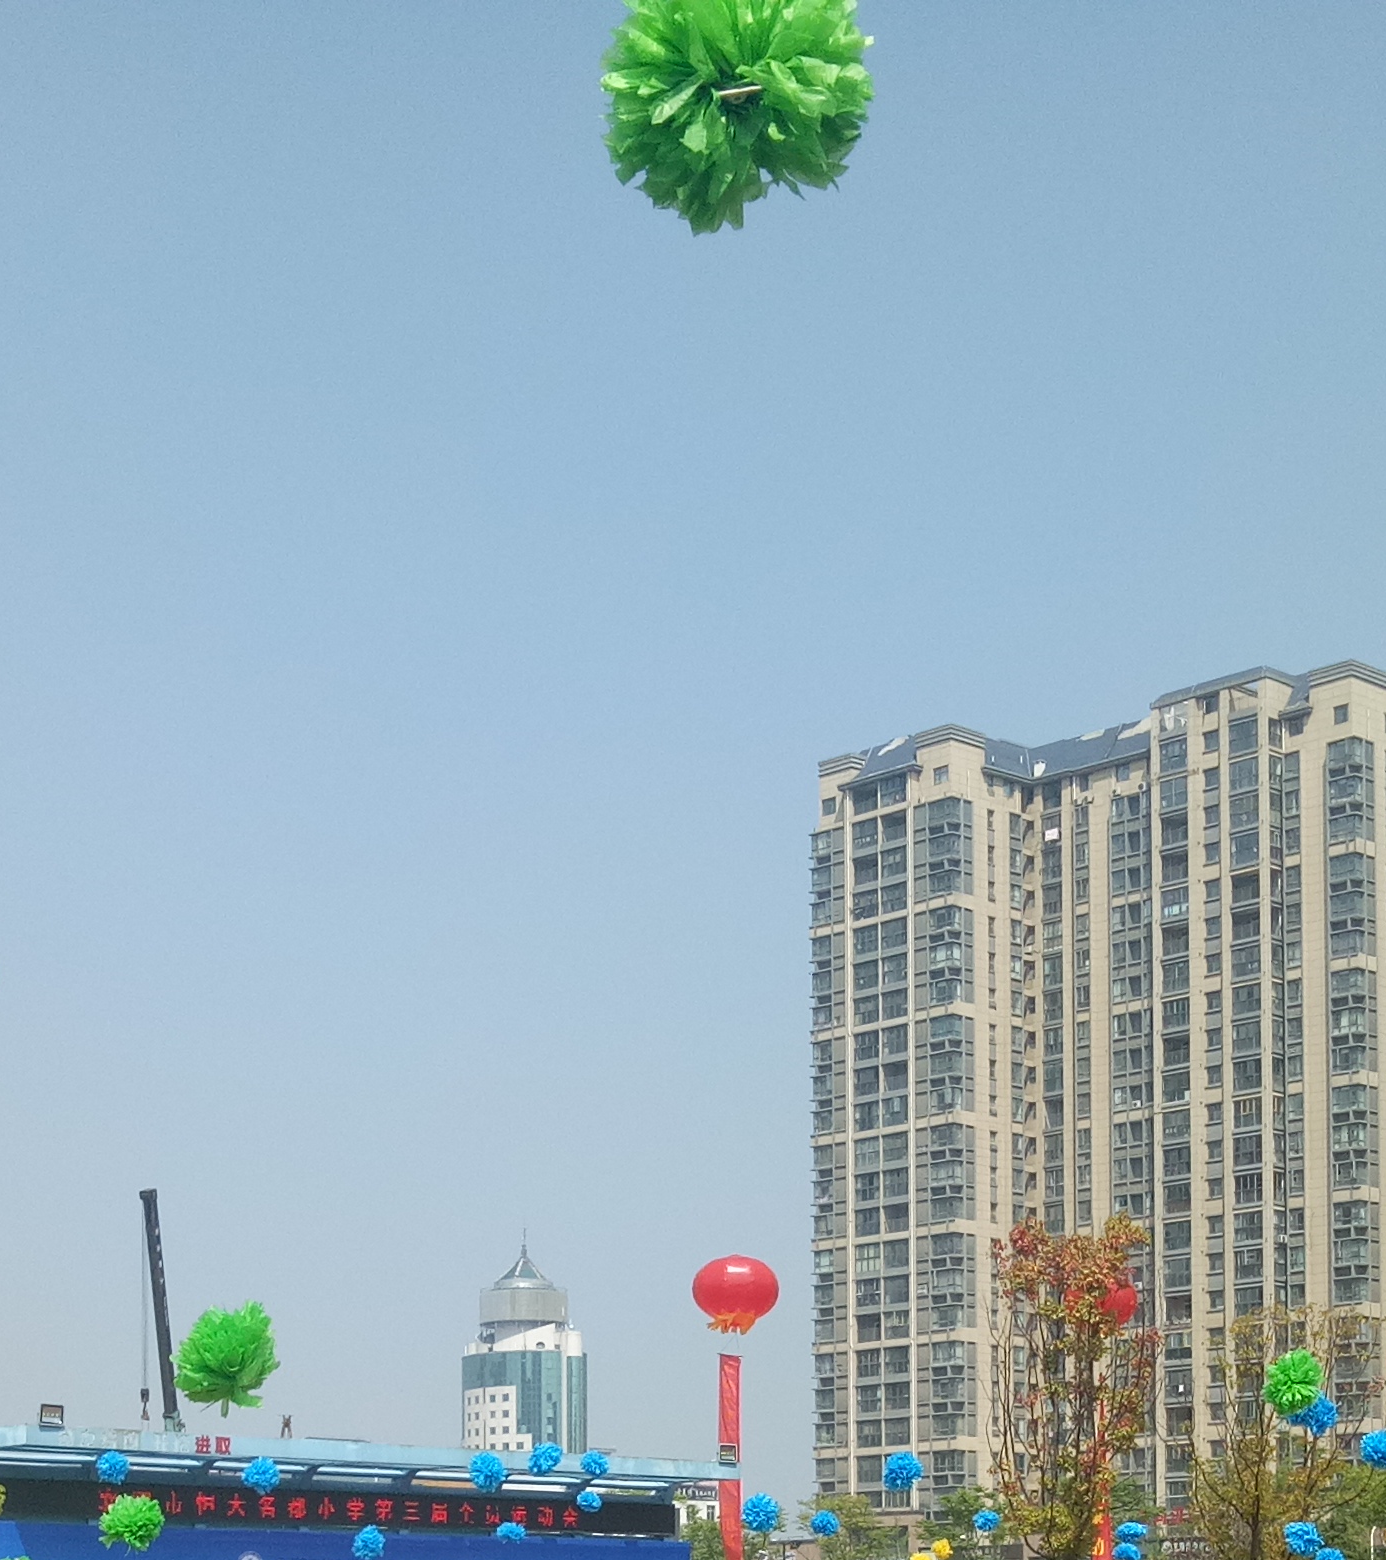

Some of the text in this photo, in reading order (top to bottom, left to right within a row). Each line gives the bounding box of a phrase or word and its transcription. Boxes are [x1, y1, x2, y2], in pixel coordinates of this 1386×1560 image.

[195, 1435, 231, 1455] 进取
[98, 1490, 579, 1528] 市恒大名都小学第三届全员运动会
